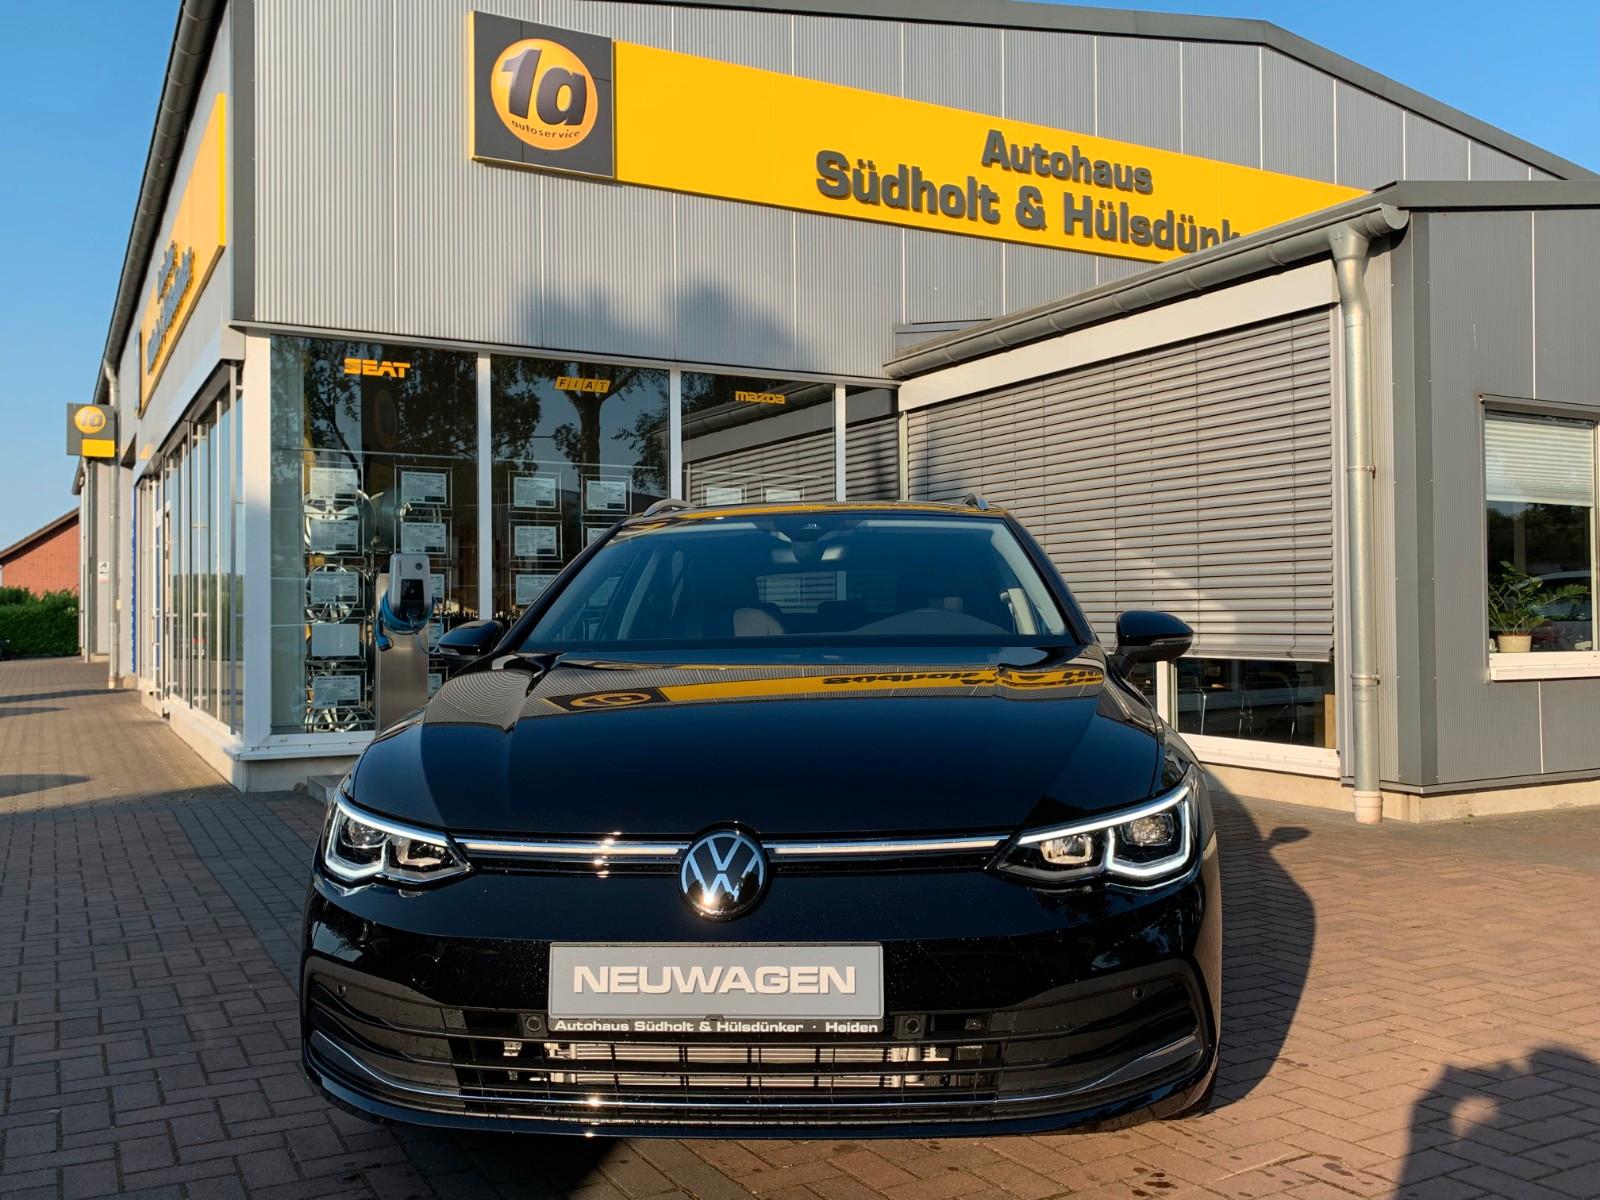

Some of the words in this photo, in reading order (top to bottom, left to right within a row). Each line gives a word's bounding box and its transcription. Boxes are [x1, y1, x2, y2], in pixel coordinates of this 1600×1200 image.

[502, 48, 588, 126] 1a
[511, 120, 581, 138] autoservice
[981, 129, 1153, 195] Autohaus
[816, 149, 1001, 224] Südholt
[1015, 184, 1048, 231] &
[344, 358, 411, 378] SEAT
[557, 378, 610, 393] FIAT
[735, 391, 786, 405] mazda
[573, 965, 857, 995] NEUWAGEN
[554, 1020, 630, 1032] Autohaus
[634, 1020, 694, 1032] Südholt
[698, 1020, 712, 1032] &
[716, 1021, 804, 1033] Hülsdünker
[825, 1021, 878, 1033] Heiden
